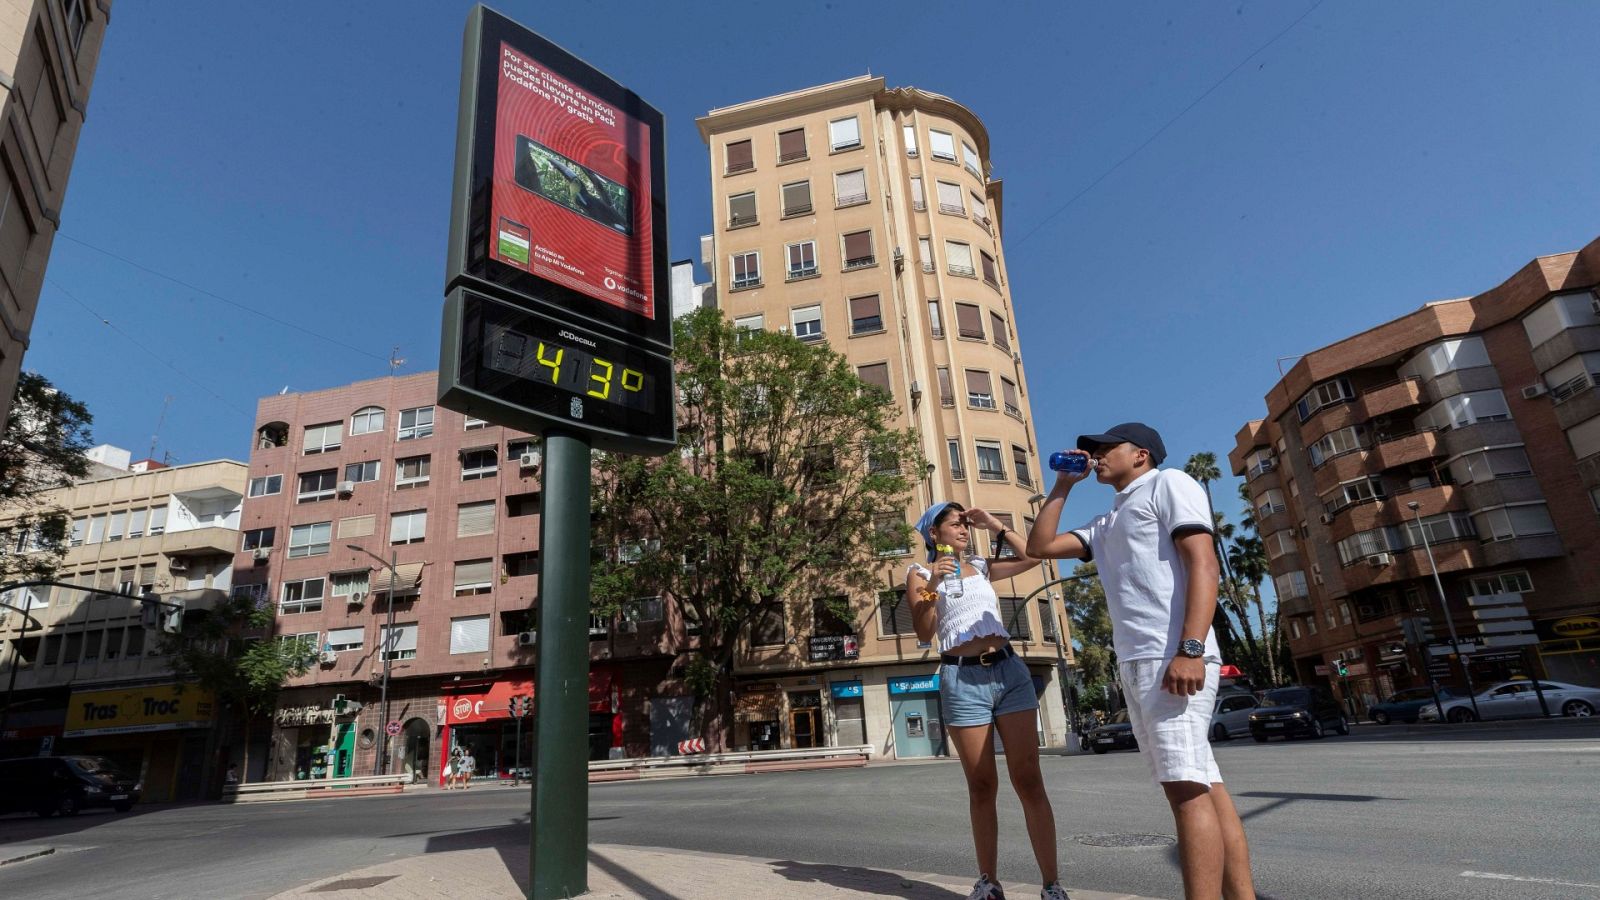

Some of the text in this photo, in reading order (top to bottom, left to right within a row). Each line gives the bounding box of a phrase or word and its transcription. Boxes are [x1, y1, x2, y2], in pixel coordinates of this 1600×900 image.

[503, 48, 616, 119] Por ser cliente de móvil,
[503, 60, 616, 128] puedes llevarte un Pack
[503, 69, 594, 125] Vodafone TV gratis
[617, 284, 648, 302] vodafone
[558, 329, 597, 348] JCDecaux
[83, 696, 180, 721] Tras Troc
